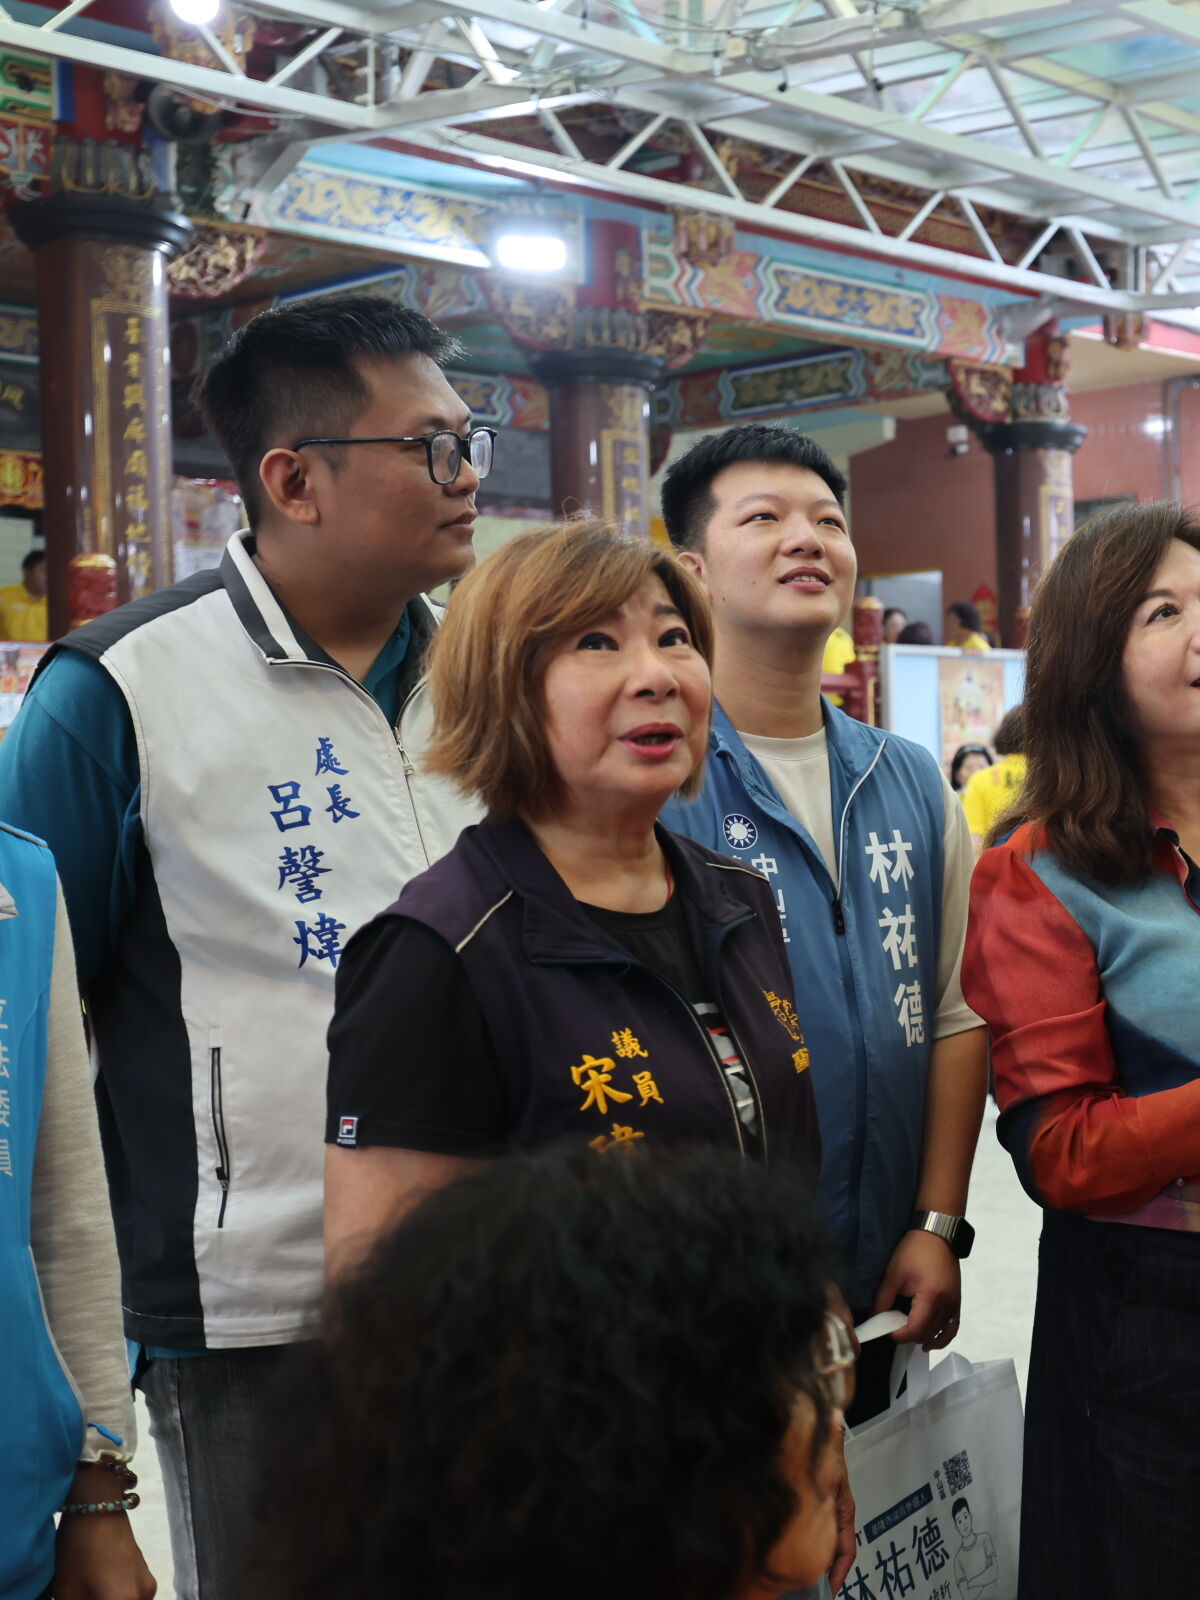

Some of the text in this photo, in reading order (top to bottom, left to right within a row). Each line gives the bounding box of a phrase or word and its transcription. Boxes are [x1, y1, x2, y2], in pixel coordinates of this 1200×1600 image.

[314, 736, 361, 824] 處長
[864, 829, 925, 1048] 林祐德
[611, 1027, 665, 1107] 議員
